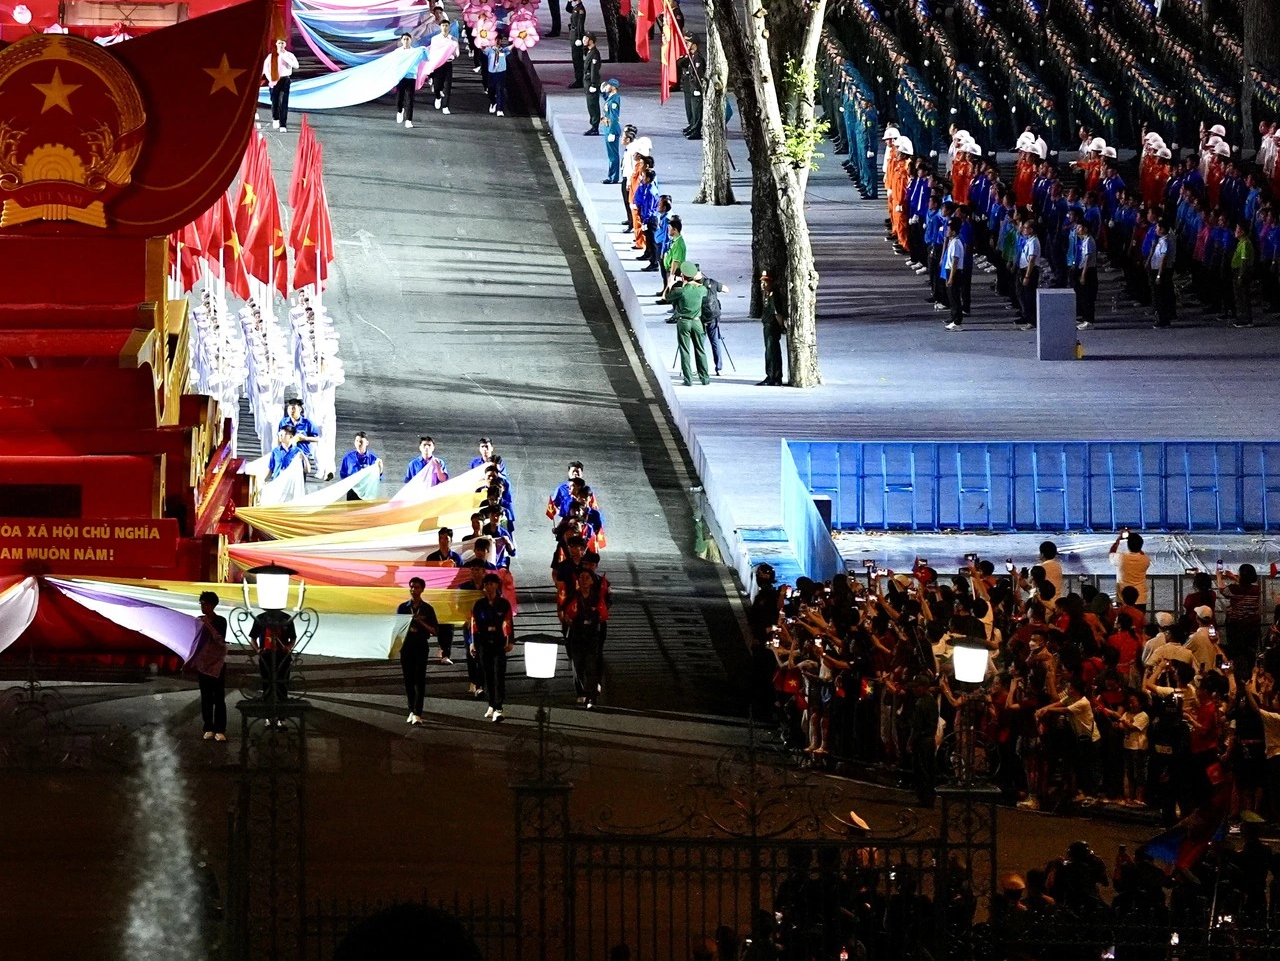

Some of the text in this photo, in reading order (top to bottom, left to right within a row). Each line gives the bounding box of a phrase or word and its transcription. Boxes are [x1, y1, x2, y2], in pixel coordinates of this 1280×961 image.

[26, 523, 49, 538] XÃ
[52, 523, 79, 540] HỘI
[82, 523, 111, 539] CHỦ
[114, 525, 161, 539] NGHĨA
[26, 546, 70, 560] MUÔN
